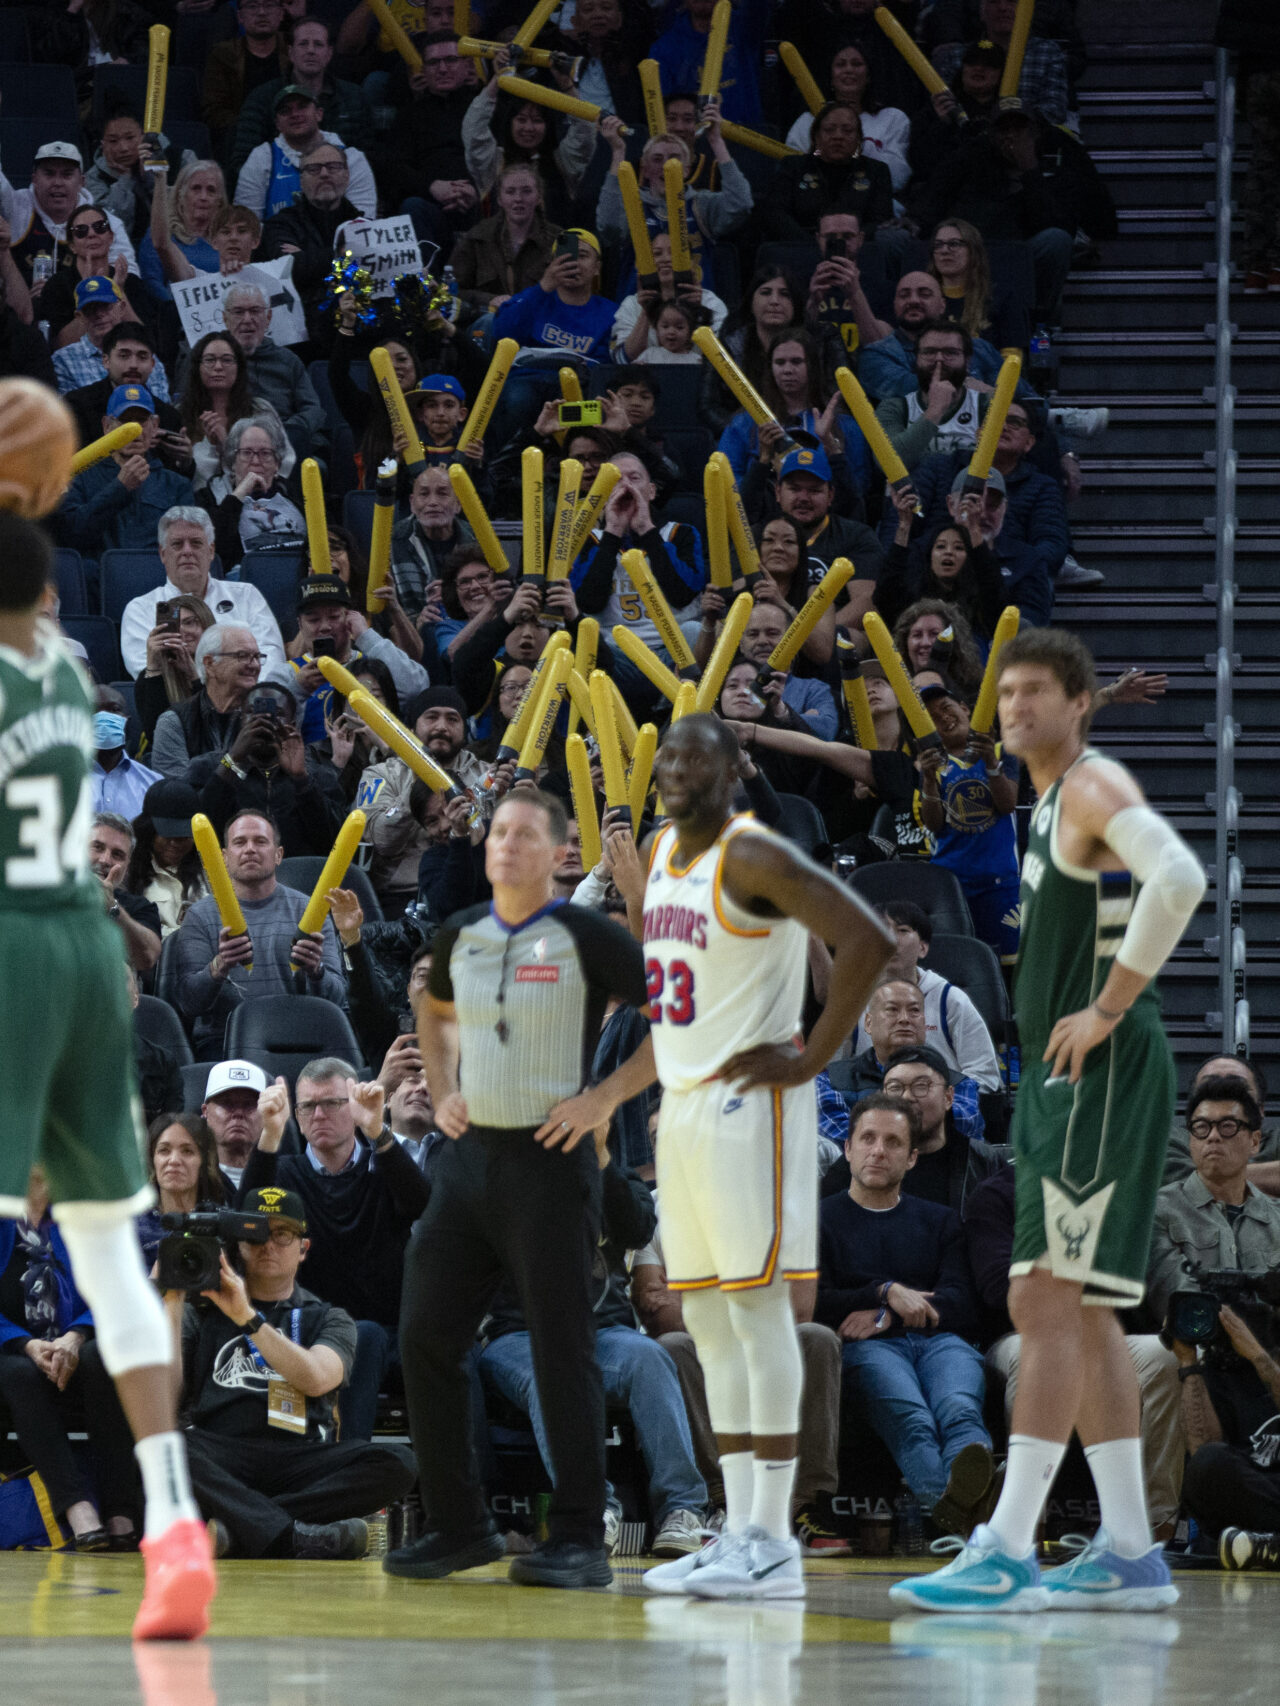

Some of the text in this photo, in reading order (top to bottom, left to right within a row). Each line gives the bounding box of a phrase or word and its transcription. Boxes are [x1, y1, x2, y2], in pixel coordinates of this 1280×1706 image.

[355, 224, 414, 247] TYLER
[541, 323, 595, 354] GSW
[533, 495, 542, 519] KAISER
[554, 509, 569, 561] WARRIORS
[651, 592, 668, 621] KAISER
[532, 697, 559, 751] WARRIORS
[357, 778, 383, 806] W
[967, 785, 985, 800] 30
[516, 967, 559, 982] Emirates
[646, 958, 696, 1026] 23
